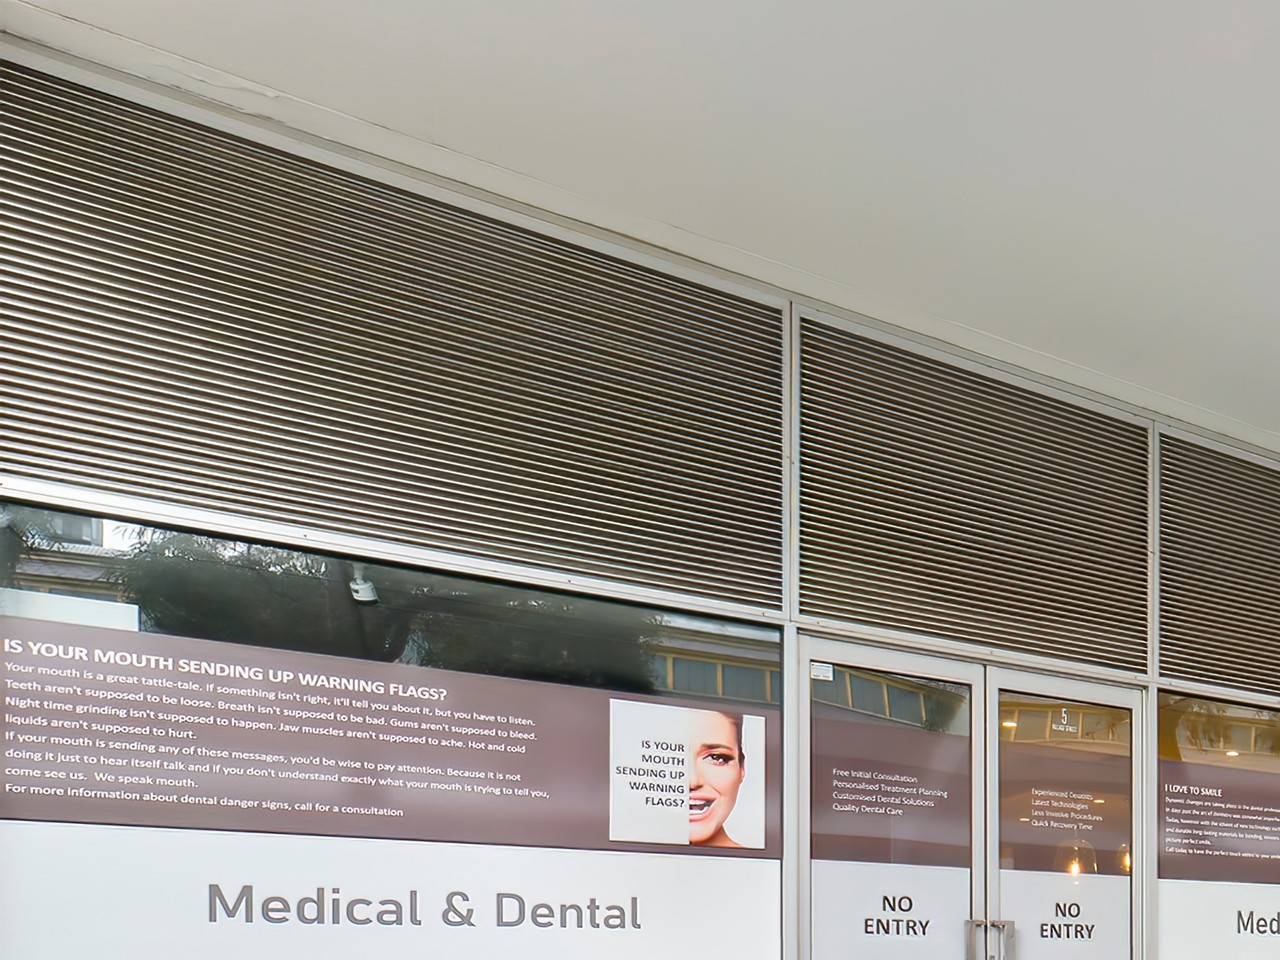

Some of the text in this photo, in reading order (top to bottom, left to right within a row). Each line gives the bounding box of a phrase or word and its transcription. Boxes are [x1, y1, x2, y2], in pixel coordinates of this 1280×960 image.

[4, 639, 447, 700] IS YOUR MOUTH SENDING UP WARNING FLAGS?
[5, 663, 34, 672] Your
[38, 668, 80, 677] mouth
[84, 671, 93, 679] is
[106, 675, 139, 684] great
[142, 678, 202, 691] tattle-tale.
[206, 684, 214, 692] If
[217, 687, 276, 700] something
[278, 692, 301, 701] isn't
[303, 695, 331, 705] right,
[334, 697, 350, 706] it'll
[392, 704, 421, 714] about
[422, 707, 433, 716] it,
[435, 708, 452, 717] but
[473, 712, 496, 722] have
[509, 716, 536, 726] listen.
[1062, 708, 1068, 724] 5
[5, 714, 197, 739] liquids aren't supposed to hurt.
[641, 740, 684, 752] IS YOUR
[642, 754, 684, 766] MOUTH
[5, 768, 42, 777] come
[94, 773, 115, 782] We
[118, 776, 154, 785] speak
[156, 779, 198, 787] mouth.
[616, 766, 684, 780] SENDING UP
[629, 782, 684, 794] WARNING
[1169, 785, 1188, 794] LOVE
[1190, 786, 1200, 795] TO
[1200, 788, 1222, 797] SMILE
[5, 784, 27, 793] For
[30, 787, 64, 795] more
[68, 788, 140, 800] information
[143, 793, 178, 802] about
[180, 795, 217, 804] dental
[220, 798, 259, 808] danger
[262, 800, 292, 810] signs,
[315, 803, 330, 812] for
[341, 807, 404, 816] consultation
[645, 797, 684, 808] FLAGS?
[208, 884, 642, 930] Medical & Dental
[882, 895, 913, 913] NO
[1055, 902, 1081, 918] NO
[864, 918, 930, 936] ENTRY
[1040, 923, 1095, 939] ENTRY
